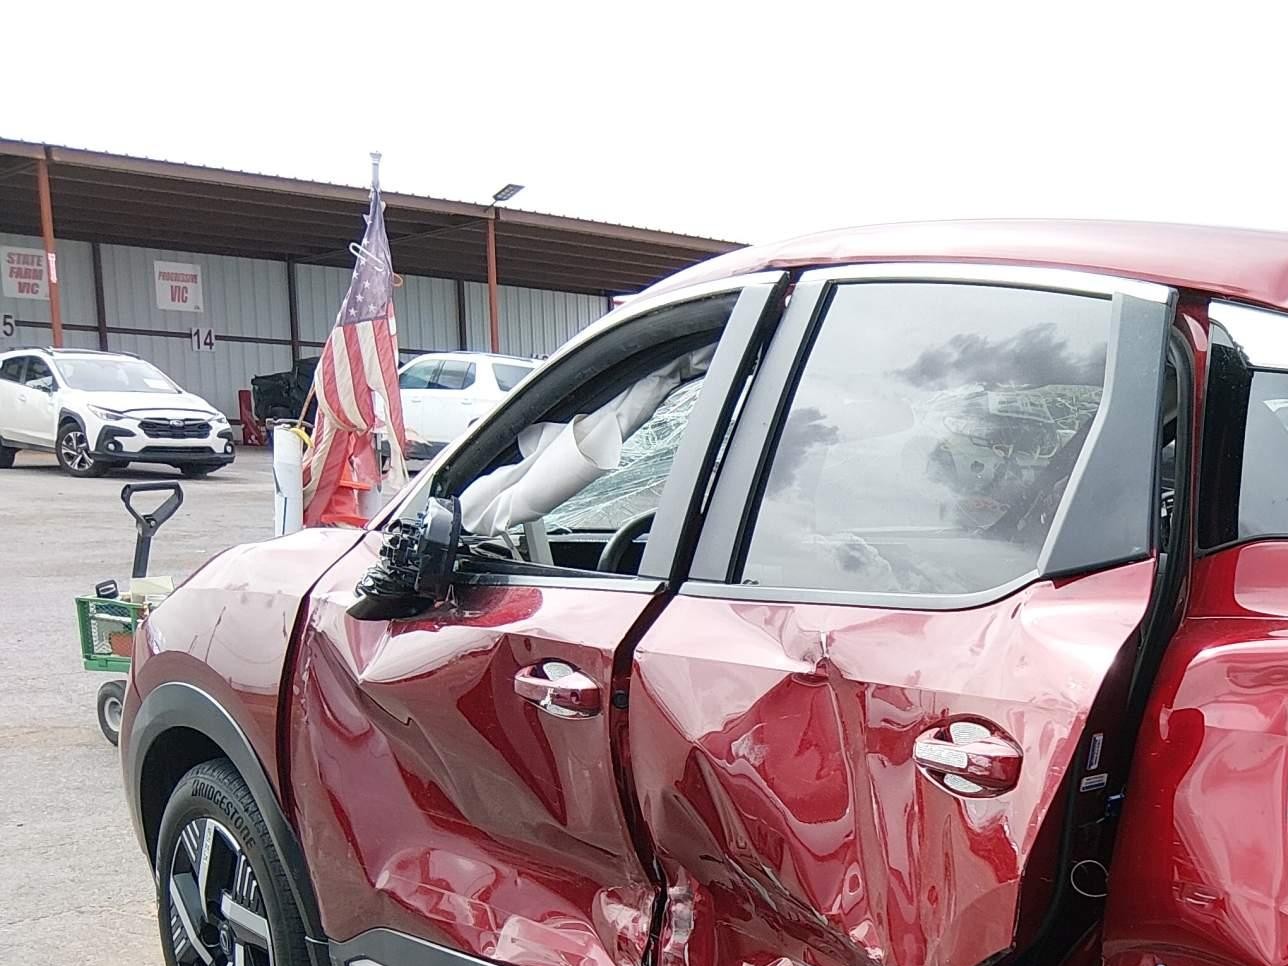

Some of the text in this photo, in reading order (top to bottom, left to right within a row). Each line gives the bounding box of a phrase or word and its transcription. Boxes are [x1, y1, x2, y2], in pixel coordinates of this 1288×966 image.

[7, 252, 43, 267] STATE
[9, 266, 43, 280] FARM
[158, 271, 198, 284] PROGRESSIVE
[18, 281, 39, 294] VIC
[170, 285, 189, 303] VIC
[193, 328, 214, 350] 14
[192, 779, 256, 849] BRIDGESTONE
